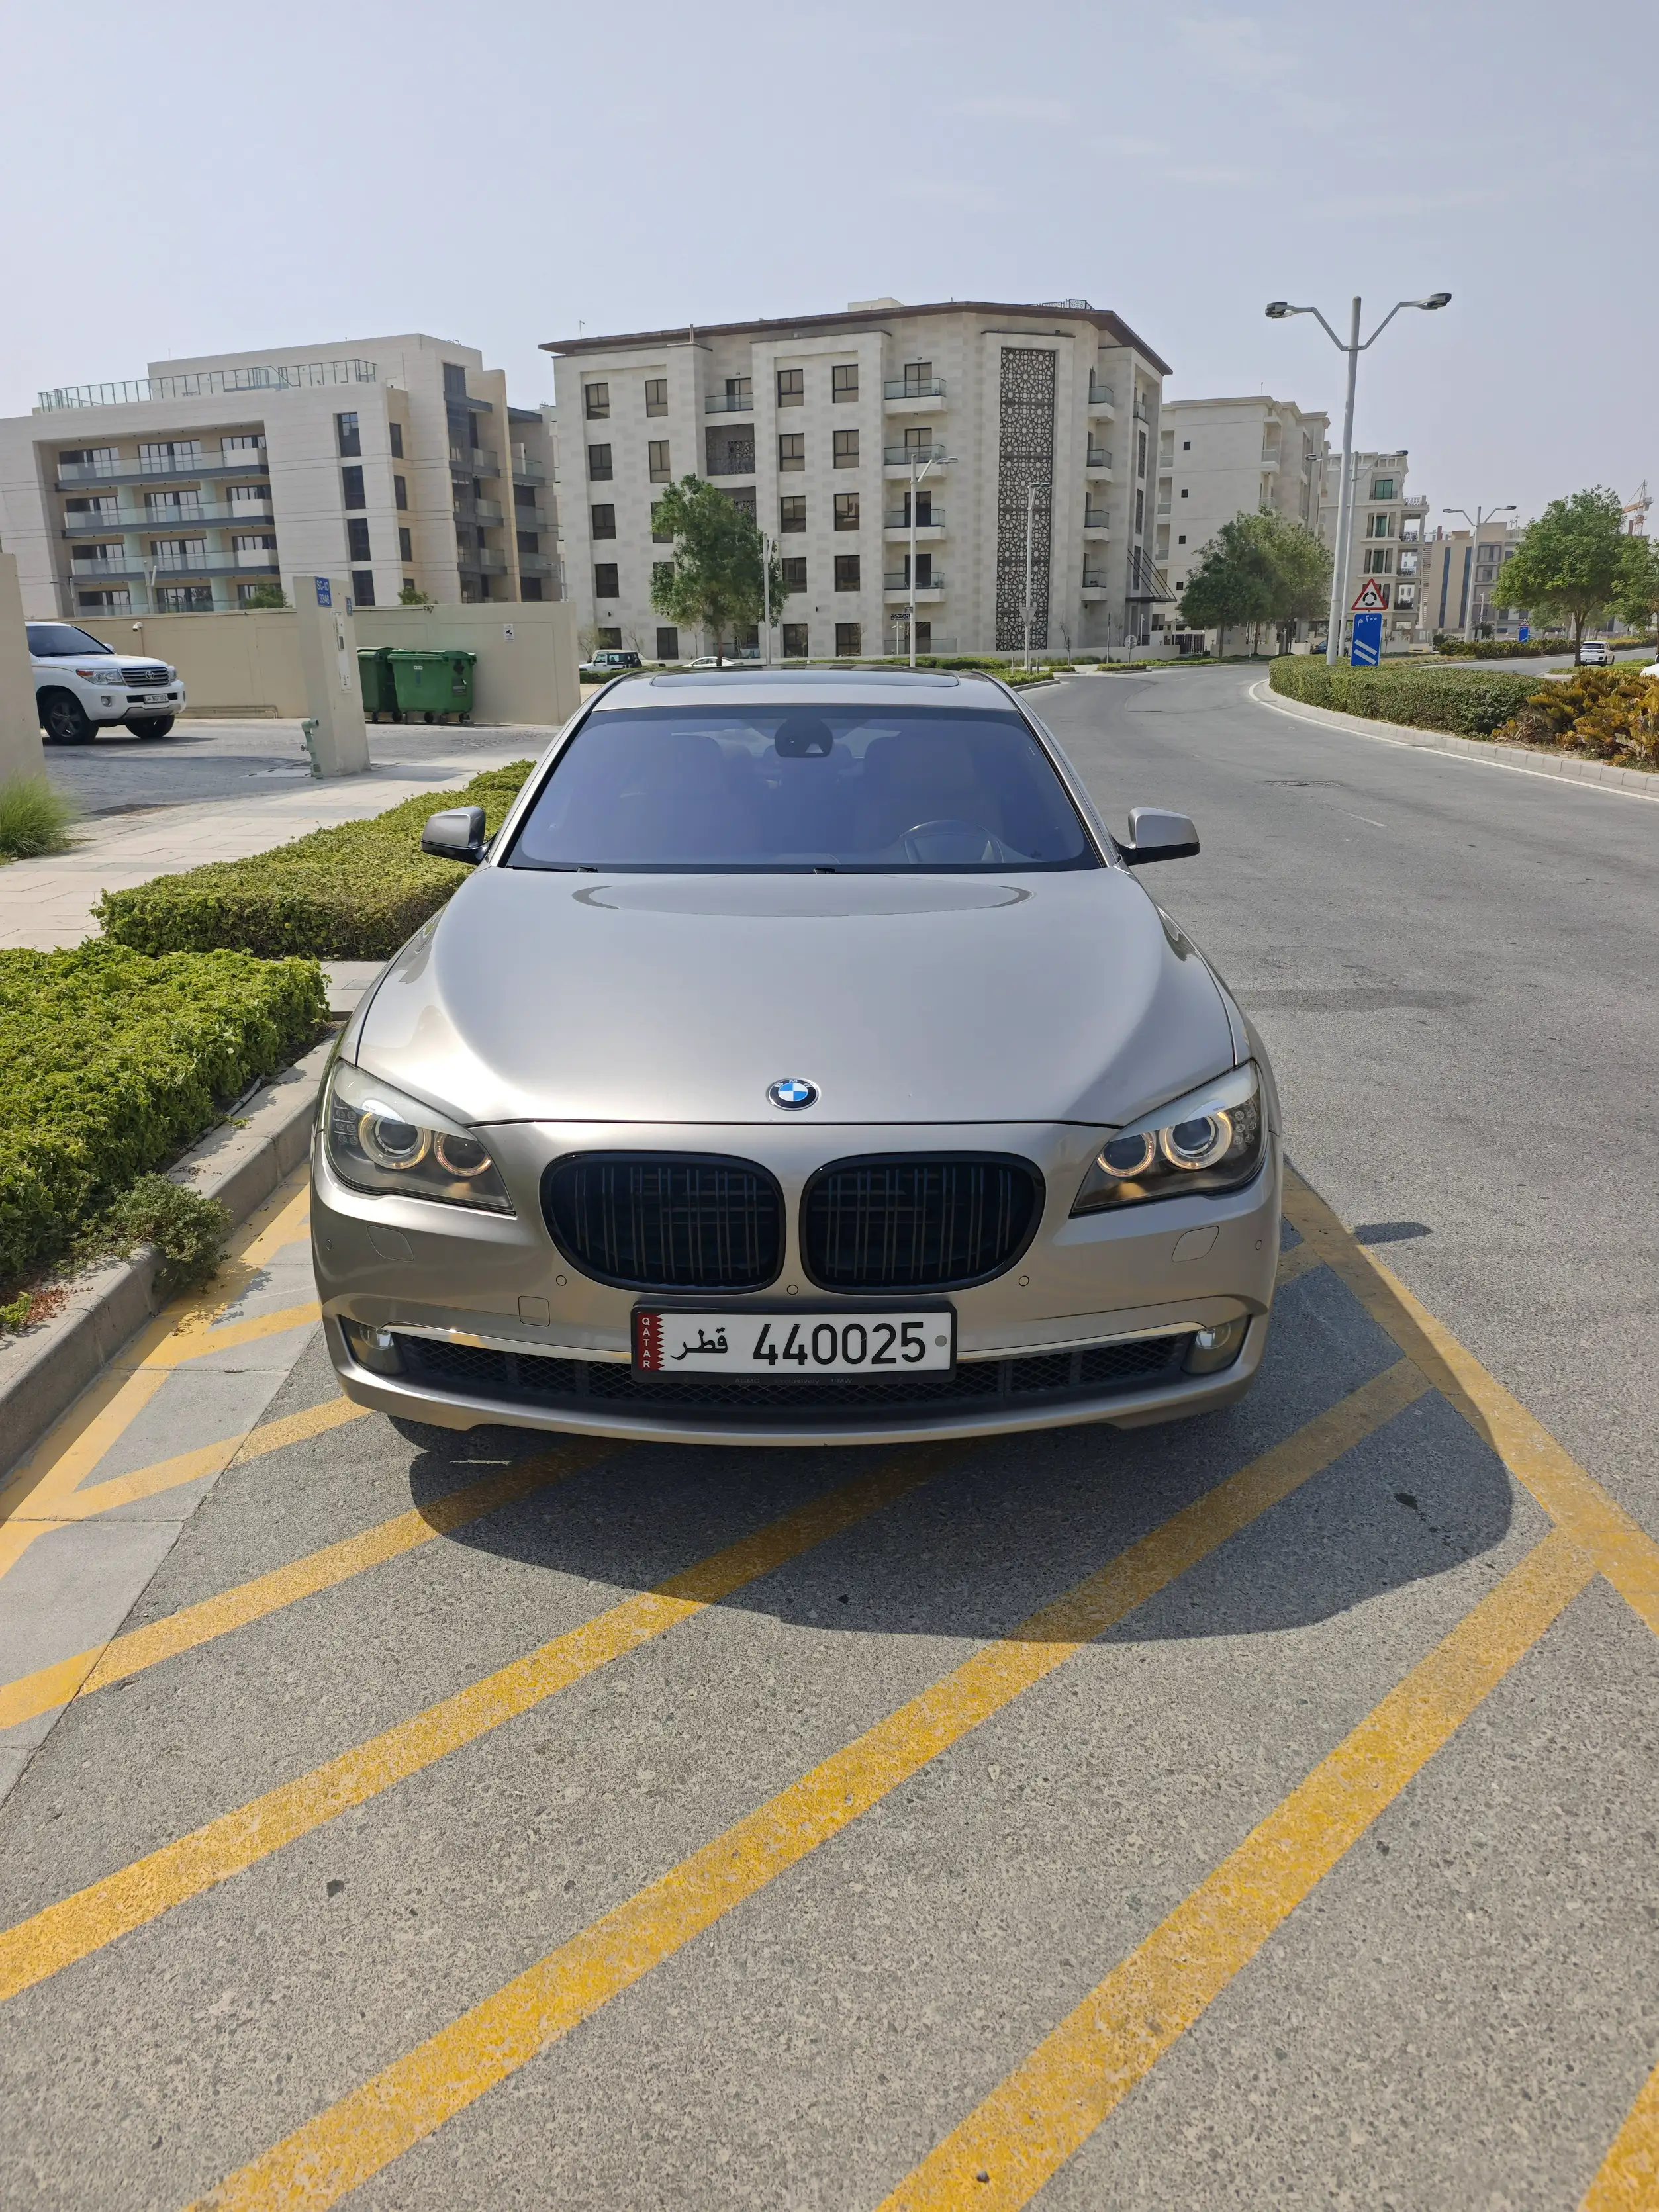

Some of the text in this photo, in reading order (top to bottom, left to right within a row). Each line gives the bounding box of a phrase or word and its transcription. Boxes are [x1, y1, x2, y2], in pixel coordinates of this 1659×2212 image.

[773, 1078, 814, 1088] BMW
[641, 1317, 651, 1368] QATAR
[670, 1326, 728, 1361] قطر
[753, 1322, 925, 1365] 440025
